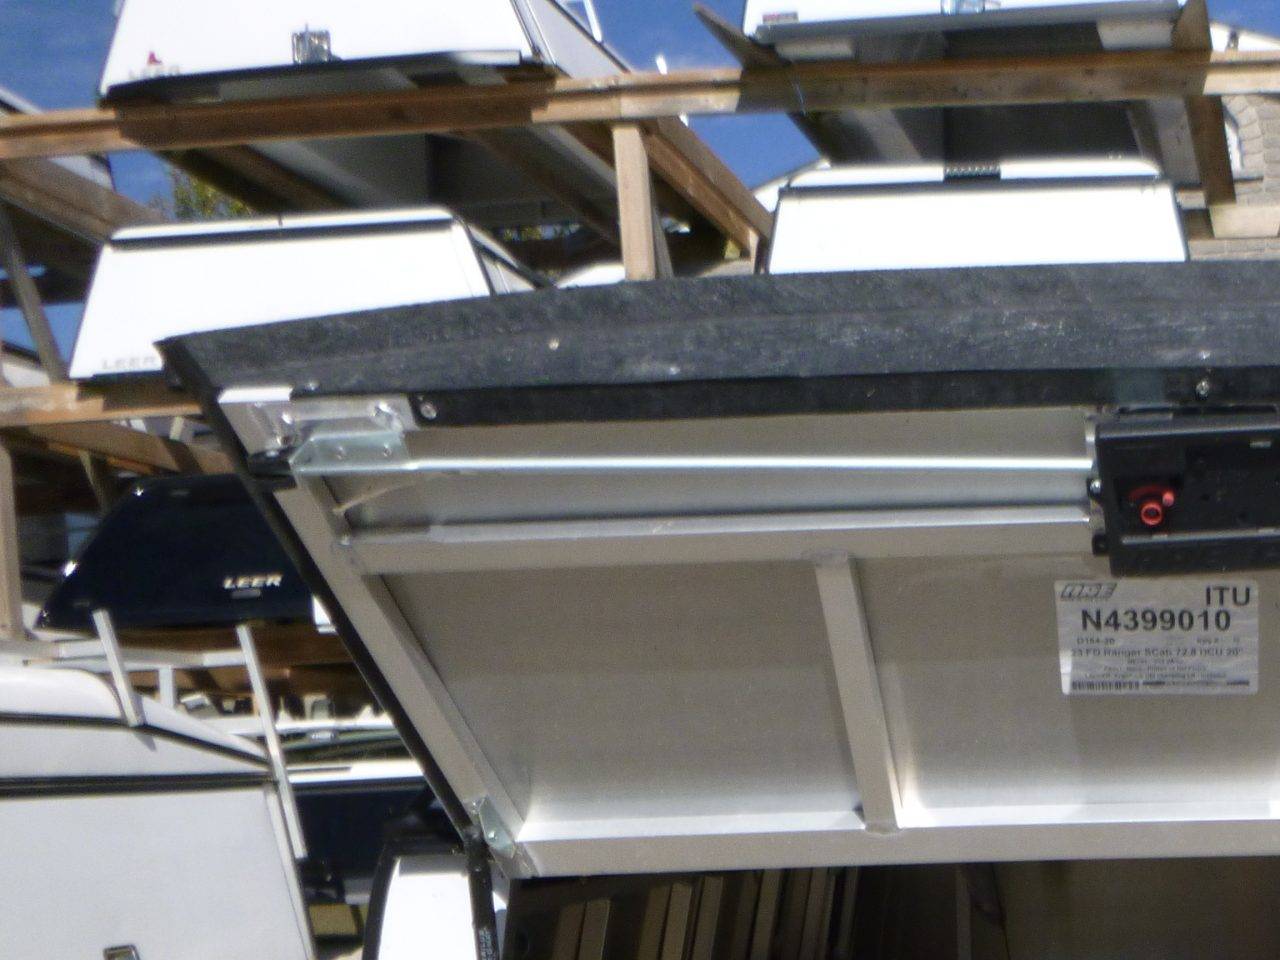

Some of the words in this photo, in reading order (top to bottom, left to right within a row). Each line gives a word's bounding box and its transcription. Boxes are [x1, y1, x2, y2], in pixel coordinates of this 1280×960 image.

[223, 573, 283, 589] LEER
[1205, 585, 1251, 607] ITU
[1081, 608, 1232, 632] N4399010
